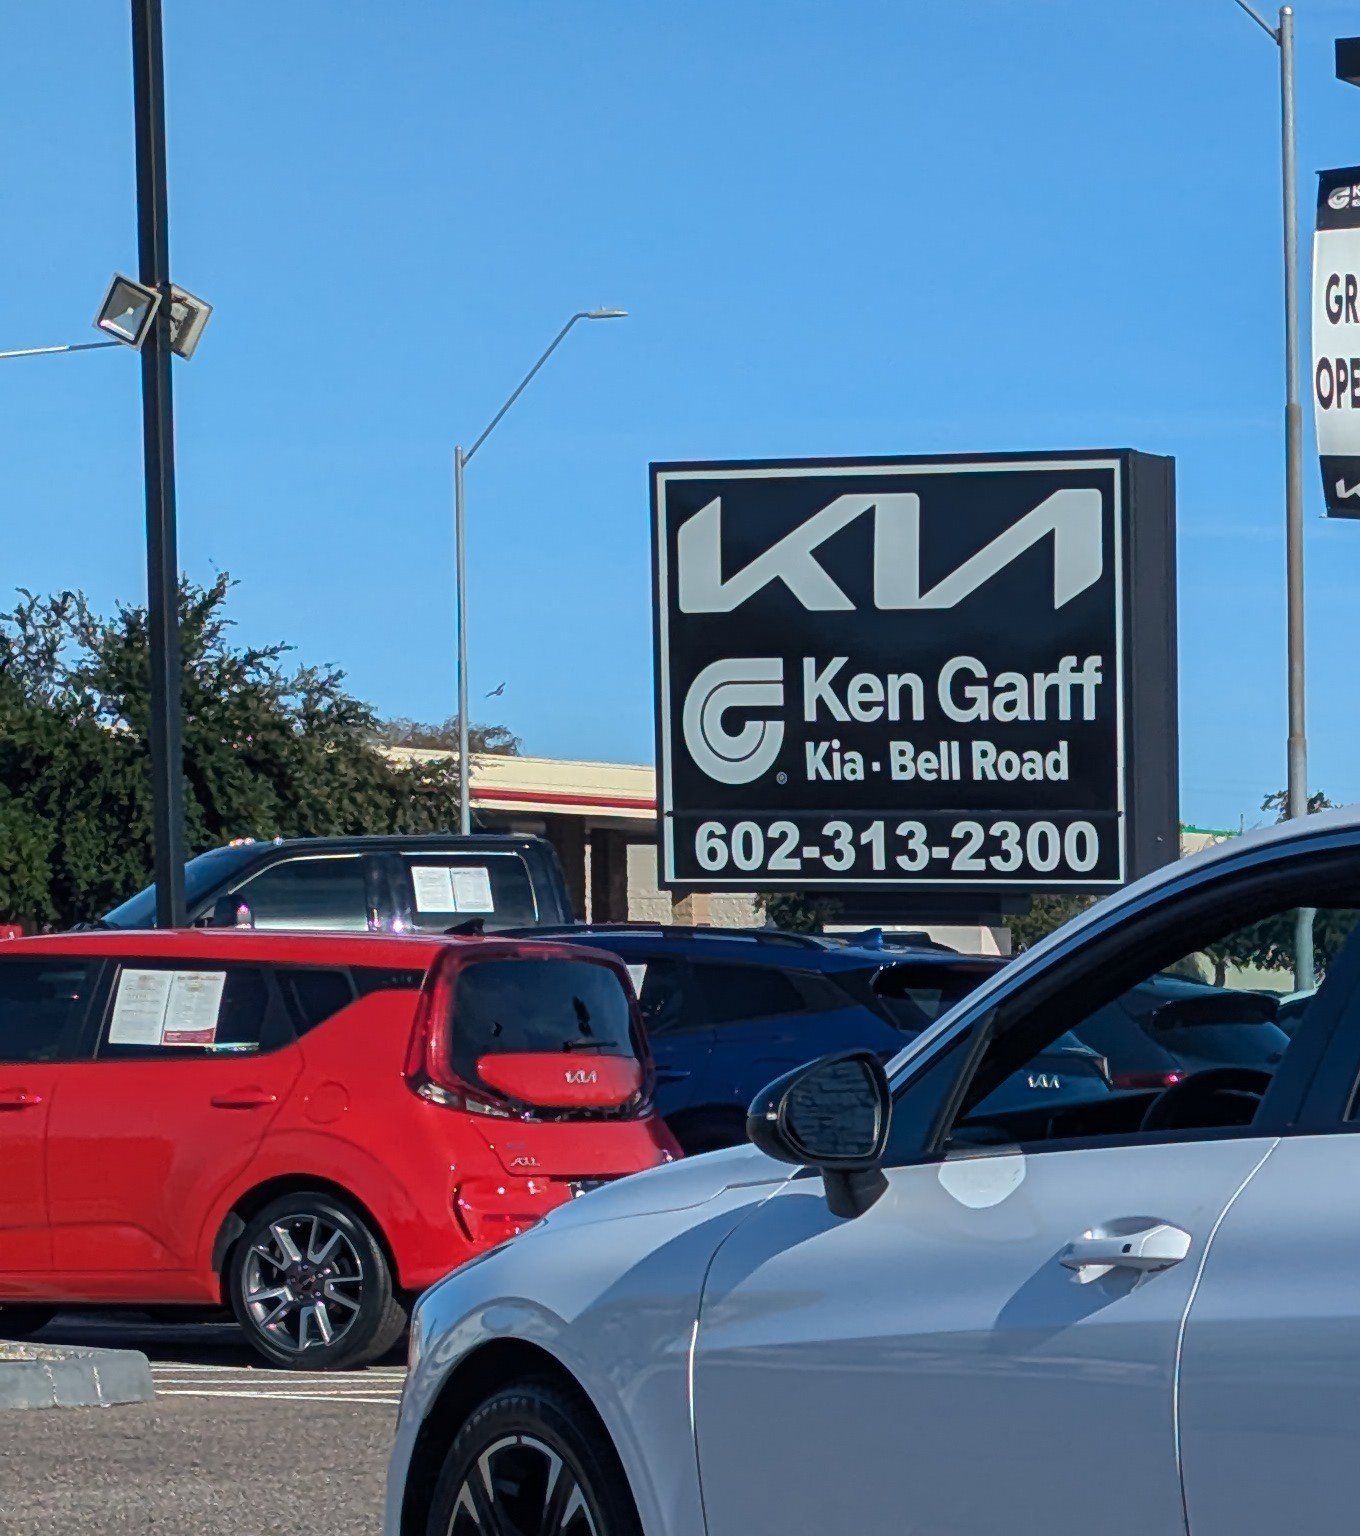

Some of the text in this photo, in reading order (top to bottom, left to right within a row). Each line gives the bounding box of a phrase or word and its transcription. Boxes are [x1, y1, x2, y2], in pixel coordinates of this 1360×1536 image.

[678, 488, 1103, 614] KIA
[802, 654, 1103, 723] Ken Garff
[805, 739, 1070, 782] Kia Bell Road
[694, 819, 1100, 873] 602-313-2300
